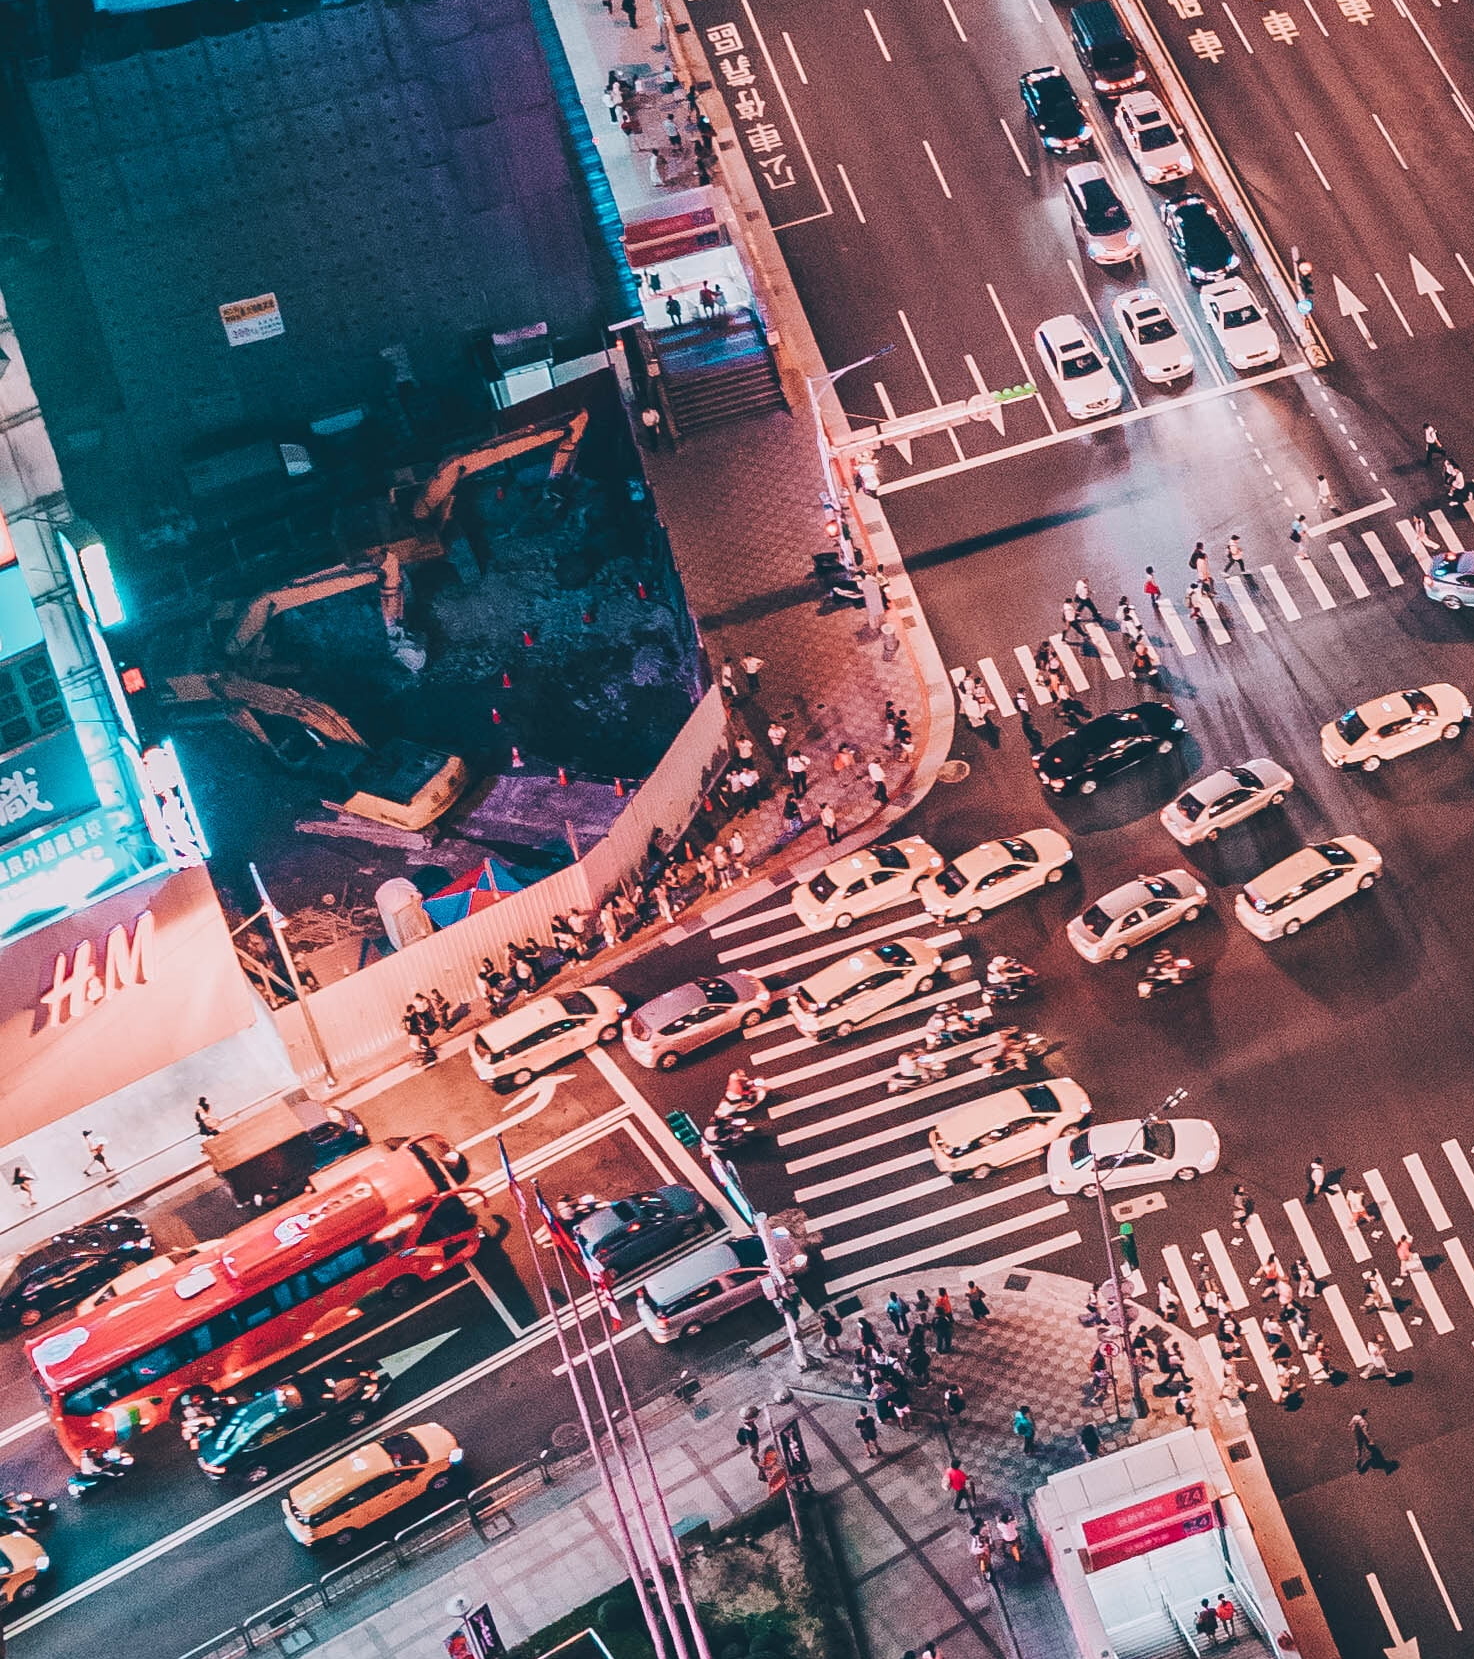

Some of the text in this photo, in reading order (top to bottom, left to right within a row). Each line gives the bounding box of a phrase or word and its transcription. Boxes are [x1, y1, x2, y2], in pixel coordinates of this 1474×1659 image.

[714, 24, 796, 191] 公車停靠區
[39, 910, 155, 1025] H&M
